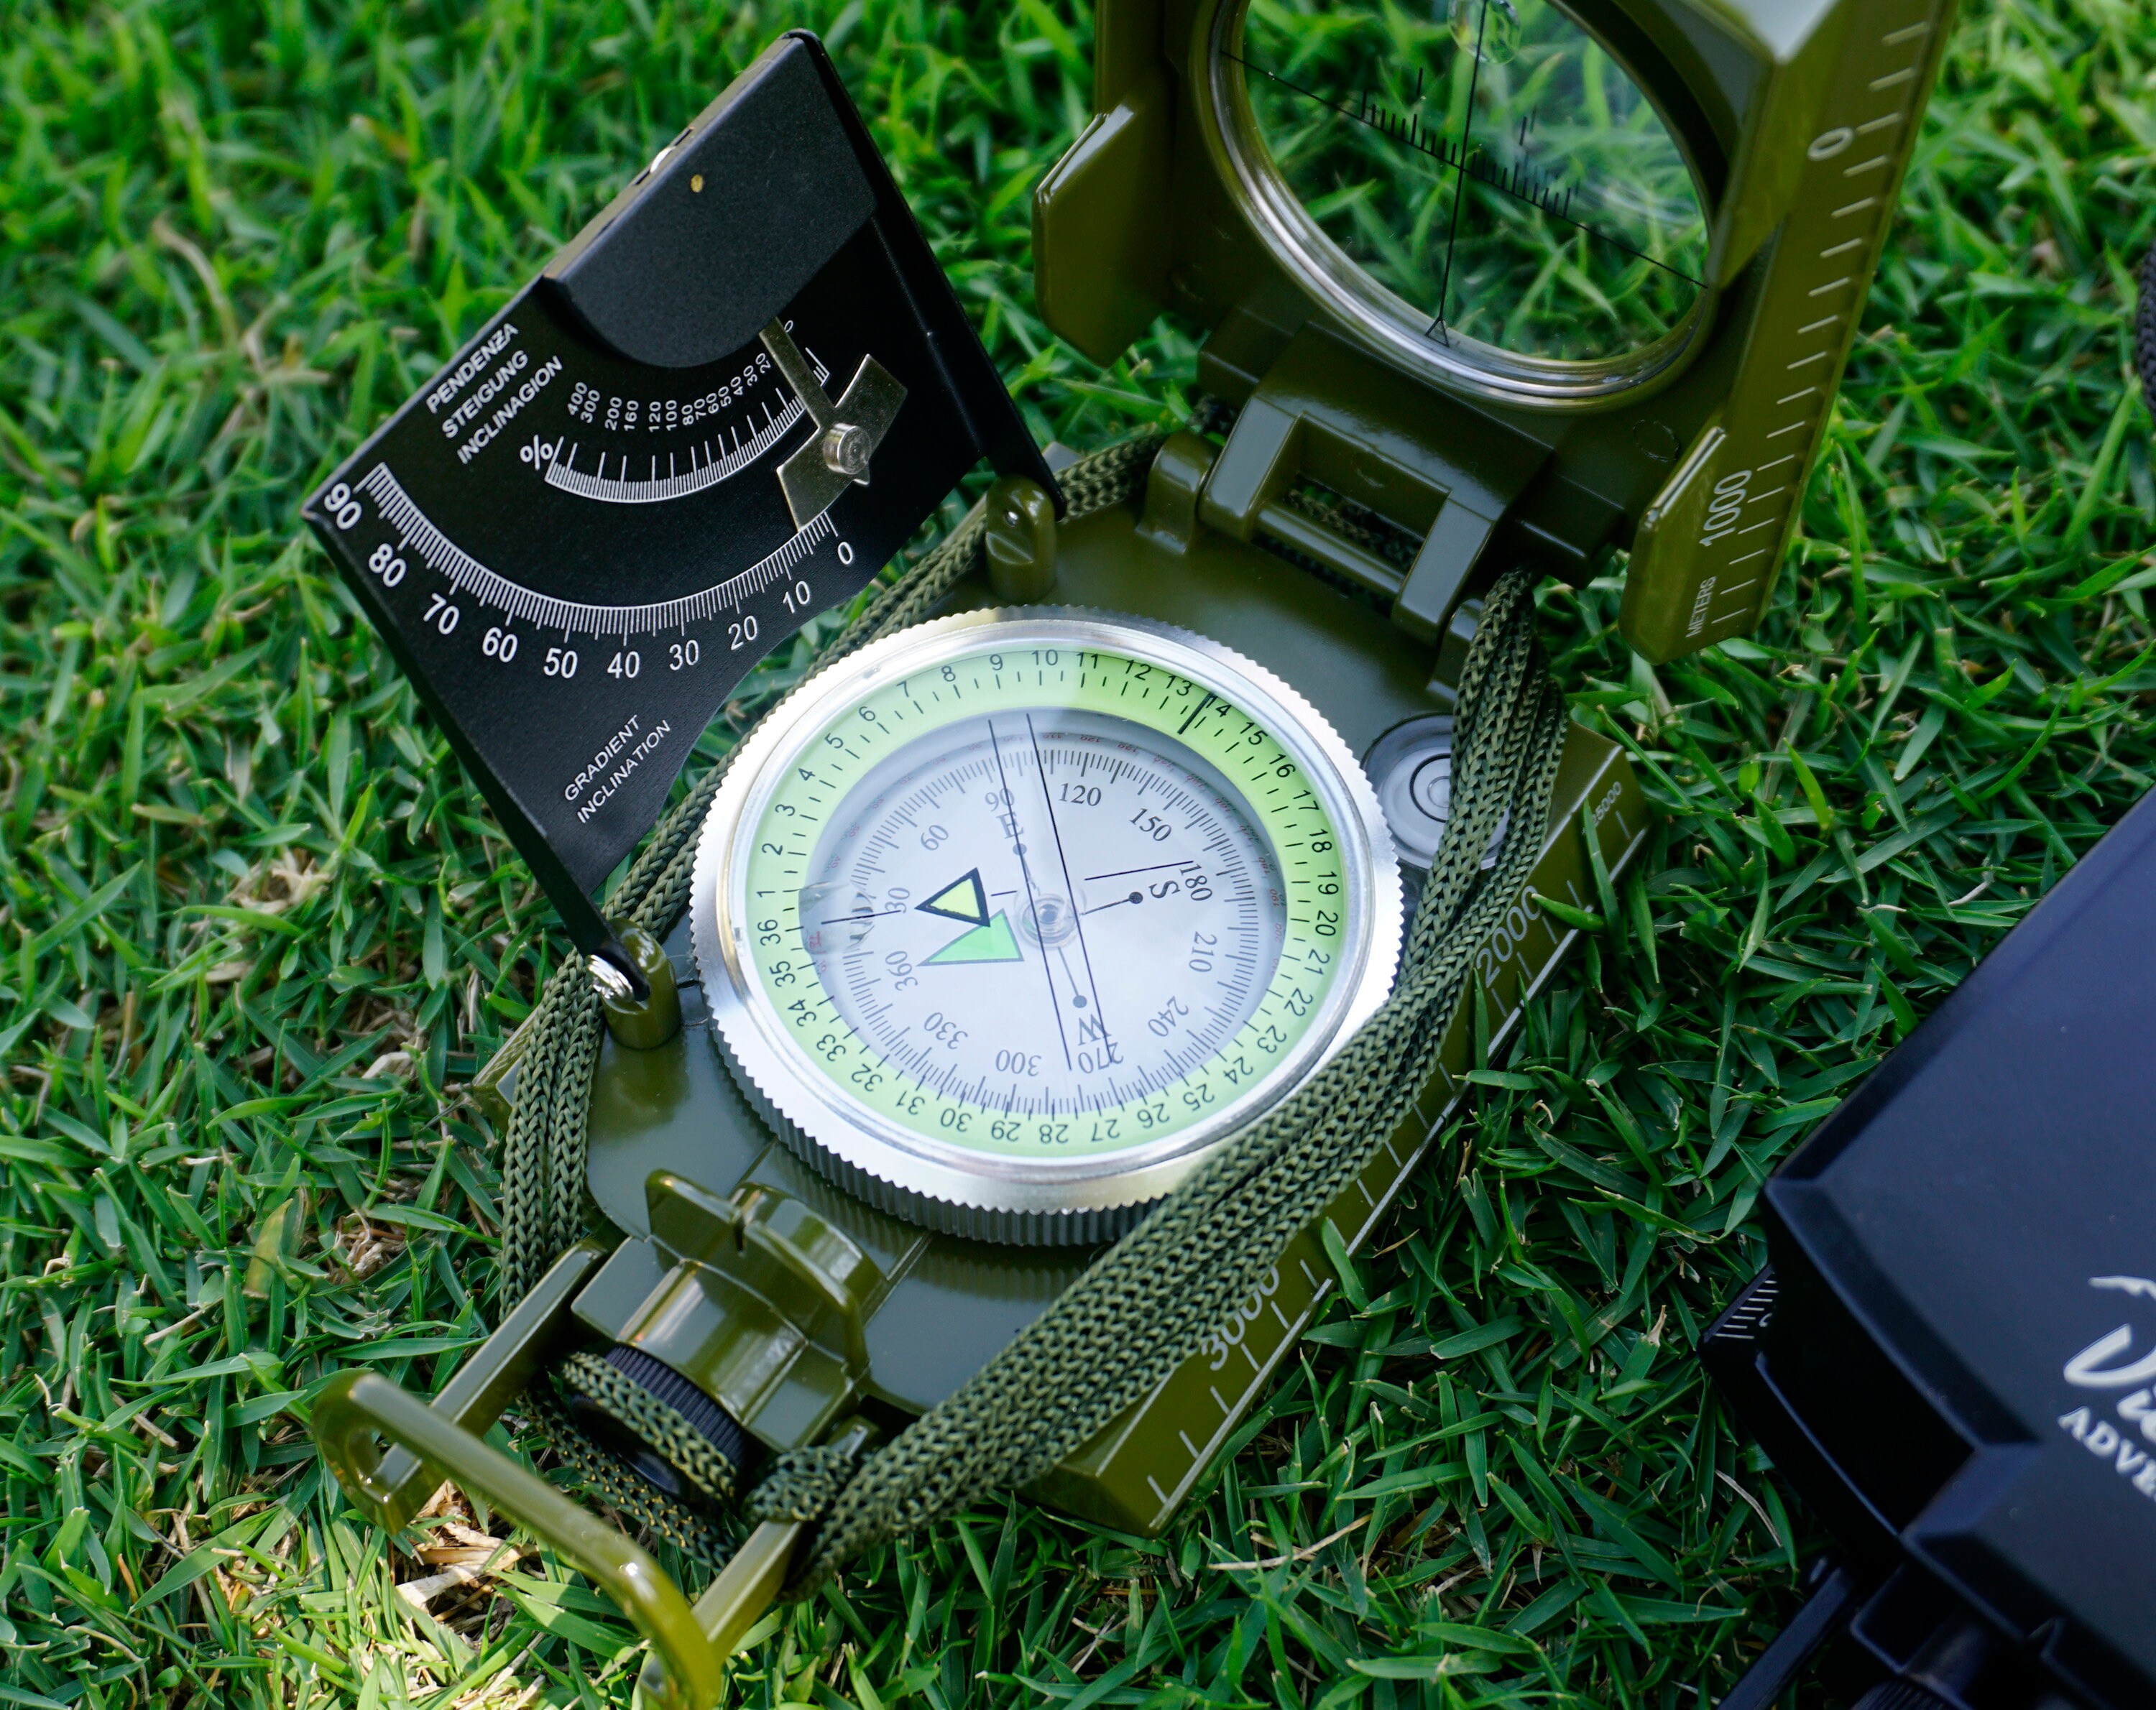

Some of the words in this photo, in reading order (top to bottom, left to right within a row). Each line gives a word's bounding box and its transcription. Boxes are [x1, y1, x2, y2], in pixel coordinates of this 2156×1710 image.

[1807, 126, 1853, 161] 0
[425, 323, 519, 414] PENDENZA
[743, 365, 757, 387] 30
[756, 353, 772, 374] 20
[442, 350, 528, 438] STEIGUNG
[567, 382, 588, 415] 400
[718, 386, 732, 407] 50
[730, 376, 744, 396] 40
[457, 355, 563, 464] INCLINAGION
[580, 389, 601, 423] 300
[604, 397, 622, 430] 200
[624, 400, 639, 431] 160
[648, 401, 661, 433] 120
[665, 399, 677, 431] 100
[681, 404, 694, 425] 80
[694, 399, 705, 420] 70
[706, 393, 719, 414] 60
[520, 434, 553, 471] %
[323, 483, 362, 530] 90
[1699, 470, 1753, 547] 1000
[369, 543, 407, 588] 80
[837, 541, 854, 565] 0
[783, 581, 811, 614] 10
[1685, 576, 1718, 638] METERS
[423, 593, 460, 635] 70
[482, 627, 518, 662] 60
[727, 615, 758, 650] 20
[543, 647, 578, 679] 50
[607, 651, 640, 679] 40
[669, 639, 699, 671] 30
[990, 654, 1003, 670] 9
[1031, 649, 1059, 666] 10
[1077, 652, 1098, 669] 11
[941, 665, 956, 682] 8
[1125, 659, 1151, 681] 12
[896, 680, 909, 698] 7
[1166, 675, 1192, 696] 13
[858, 706, 876, 721] 6
[1206, 693, 1232, 717] 14
[824, 733, 844, 749] 5
[1240, 721, 1268, 745] 15
[564, 714, 640, 800] GRADIENT
[1269, 754, 1296, 778] 16
[577, 719, 671, 823] INCLINATION
[798, 767, 816, 781] 4
[985, 787, 1015, 812] 90
[1058, 782, 1102, 806] 120
[1293, 790, 1319, 810] 17
[775, 804, 796, 816] 3
[920, 825, 949, 851] 60
[995, 811, 1024, 838] E
[1129, 808, 1172, 841] 150
[761, 843, 783, 856] 2
[1309, 828, 1332, 853] 18
[1148, 880, 1181, 899] S
[1179, 864, 1212, 901] 180
[1317, 871, 1339, 895] 19
[885, 887, 911, 913] 30
[757, 919, 781, 946] 36
[1315, 910, 1339, 936] 20
[1476, 885, 1542, 989] 2000
[1189, 931, 1217, 973] 210
[1308, 948, 1331, 975] 21
[769, 961, 796, 987] 35
[885, 951, 918, 991] 360
[788, 999, 816, 1027] 34
[1284, 988, 1314, 1017] 22
[1078, 1013, 1112, 1045] W
[1148, 996, 1189, 1037] 240
[923, 1012, 969, 1050] 330
[1257, 1025, 1286, 1053] 23
[816, 1034, 846, 1061] 33
[1078, 1042, 1124, 1073] 270
[995, 1050, 1042, 1076] 300
[1223, 1057, 1253, 1085] 24
[852, 1063, 883, 1091] 32
[895, 1091, 925, 1114] 31
[1183, 1083, 1215, 1112] 25
[940, 1108, 972, 1132] 30
[1137, 1103, 1170, 1129] 26
[991, 1120, 1021, 1142] 29
[1039, 1124, 1069, 1144] 28
[1091, 1119, 1120, 1142] 27
[1201, 1266, 1280, 1371] 3000
